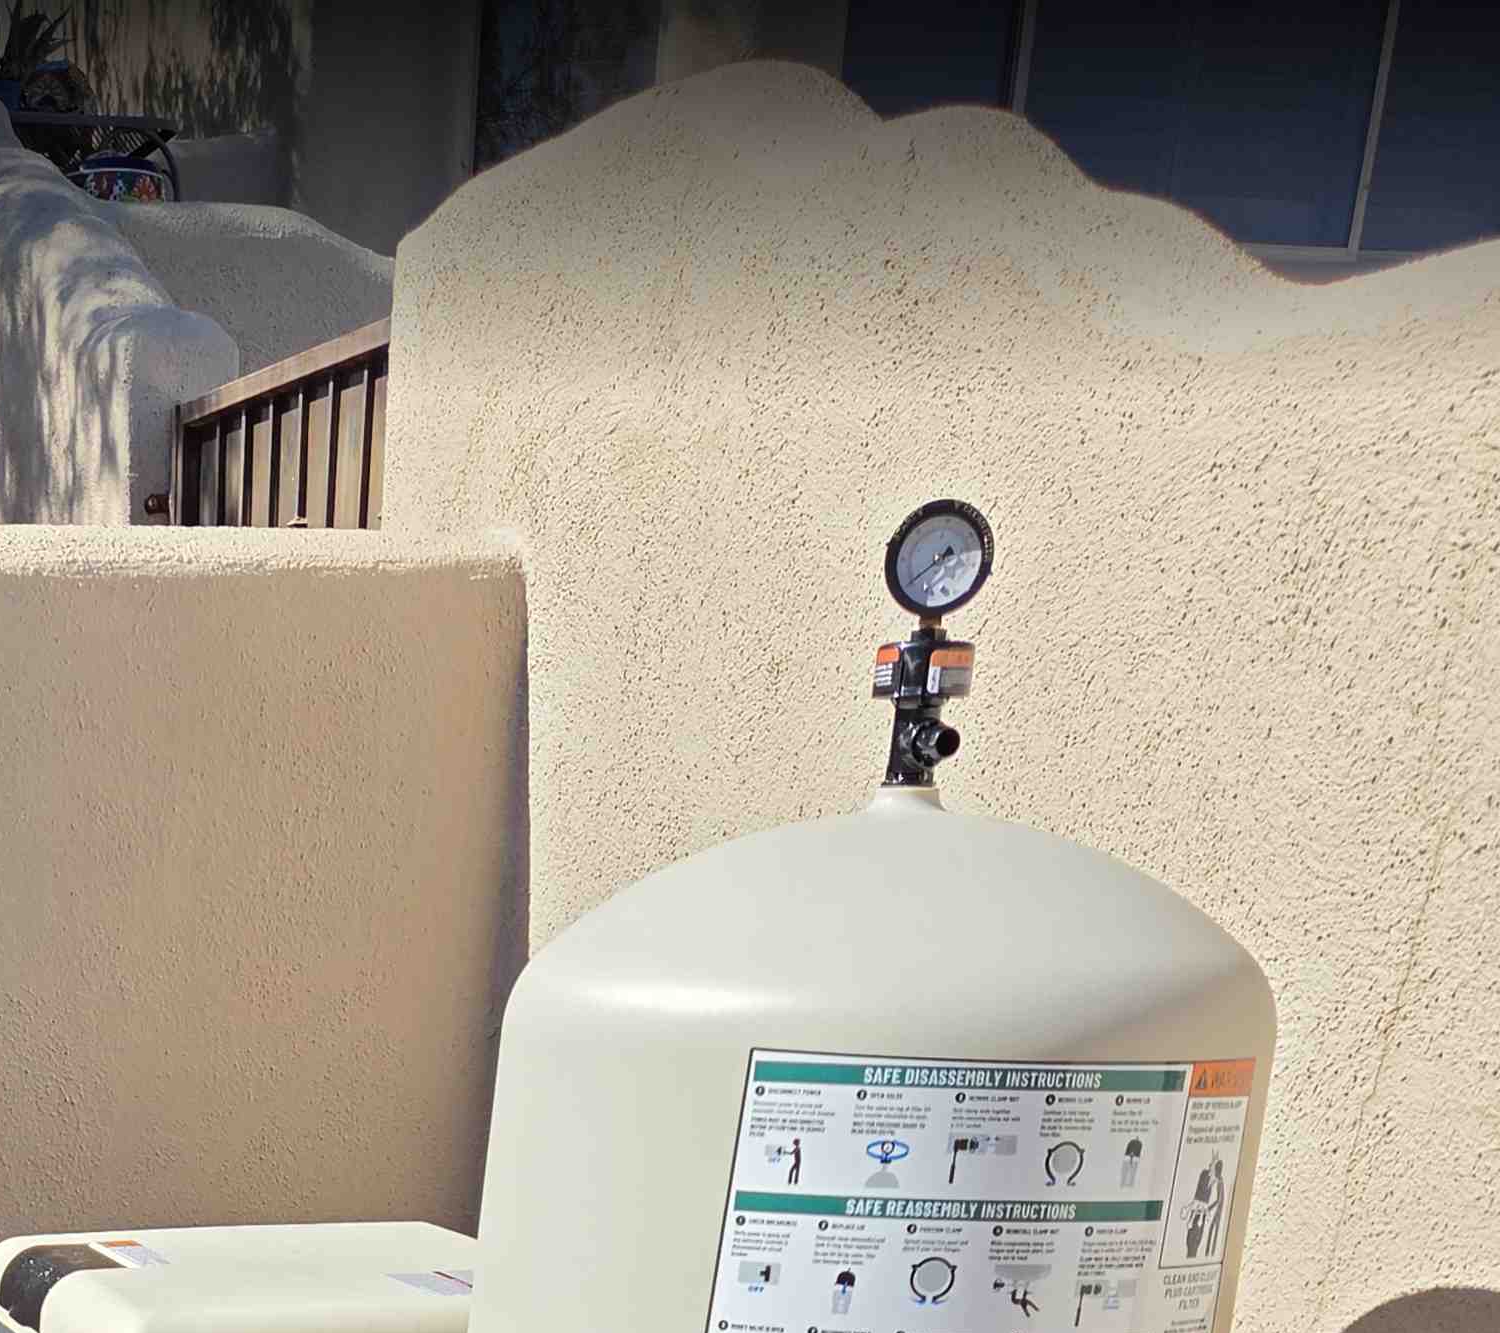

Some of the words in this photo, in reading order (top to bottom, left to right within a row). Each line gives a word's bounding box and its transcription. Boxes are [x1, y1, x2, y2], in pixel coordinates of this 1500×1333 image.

[864, 1067, 900, 1085] SAFE
[904, 1069, 1002, 1088] DISASSEMBLY
[1005, 1071, 1102, 1089] INSTRUCTIONS
[846, 1198, 884, 1217] SAFE
[886, 1199, 980, 1219] REASSEMBLY
[981, 1203, 1077, 1221] INSTRUCTIONS
